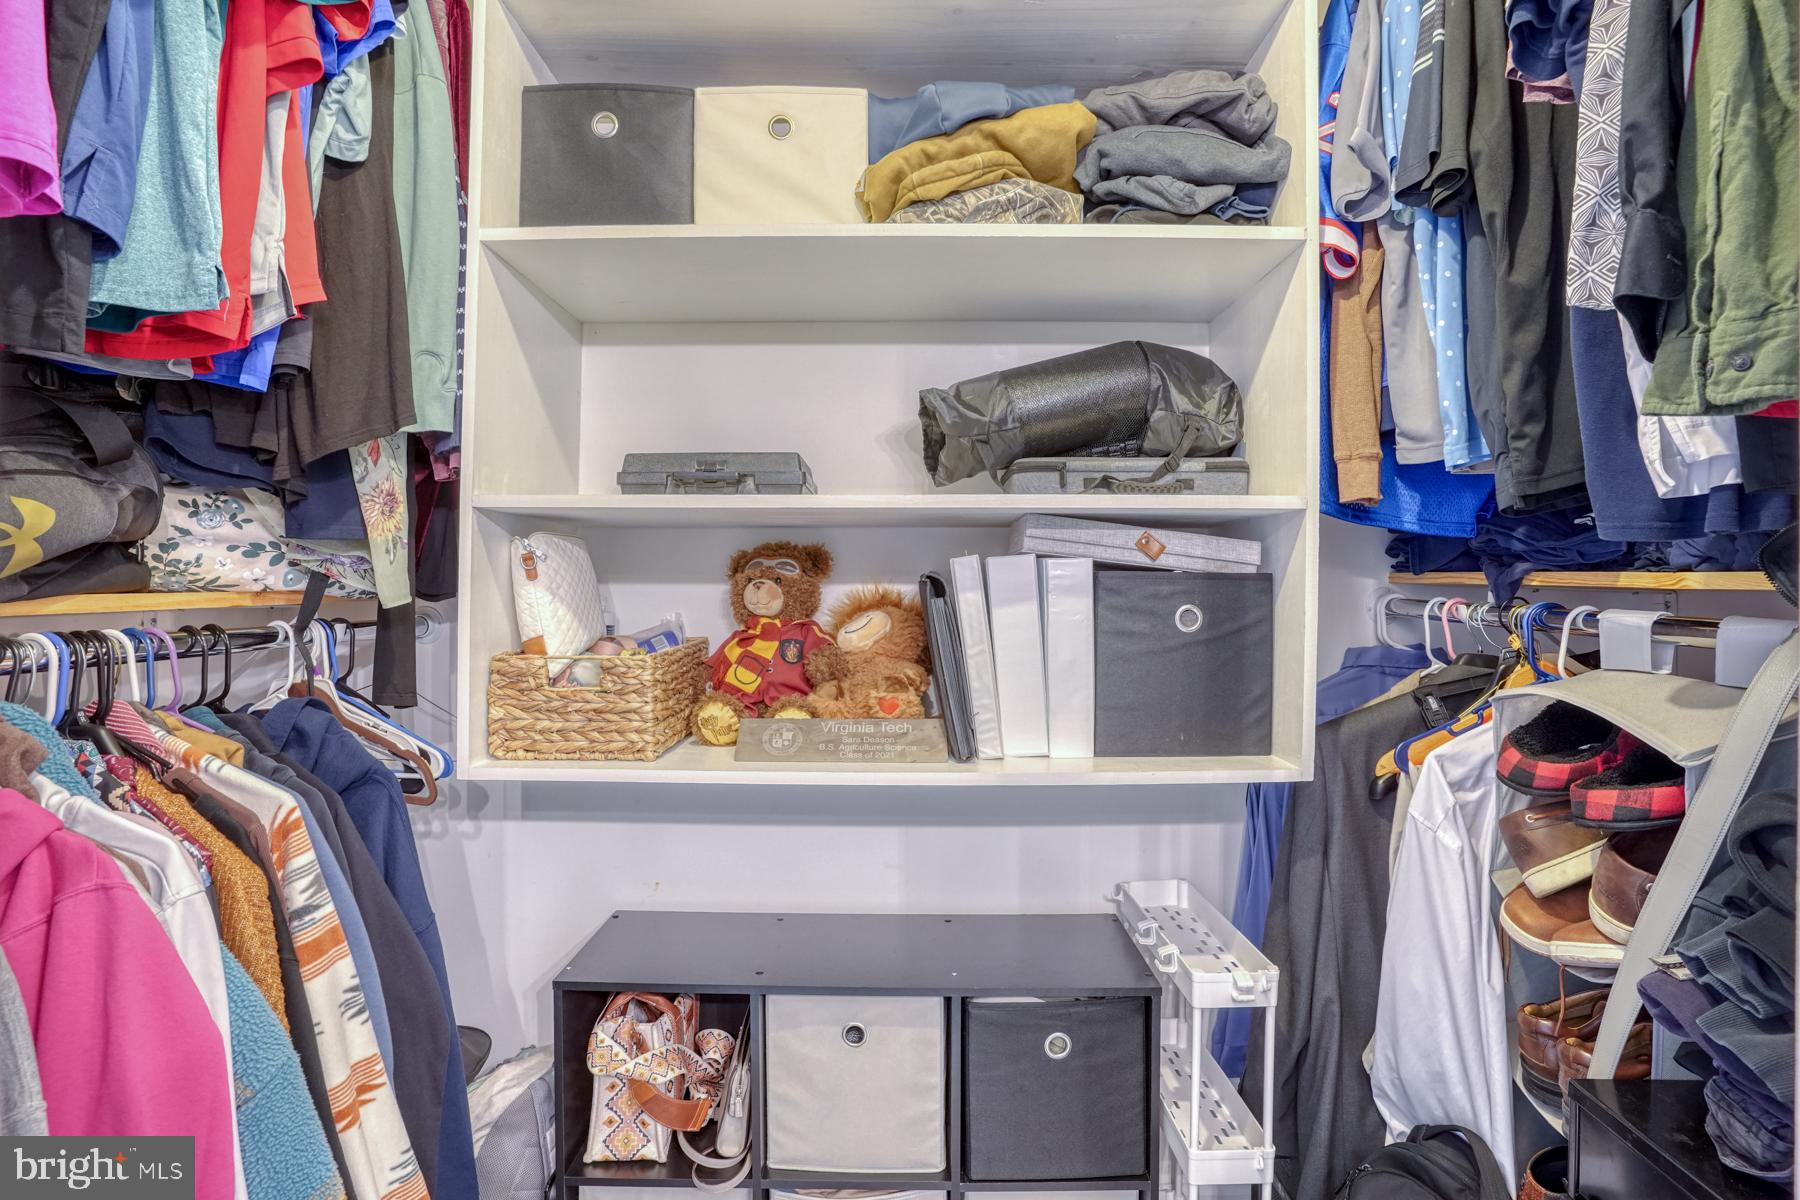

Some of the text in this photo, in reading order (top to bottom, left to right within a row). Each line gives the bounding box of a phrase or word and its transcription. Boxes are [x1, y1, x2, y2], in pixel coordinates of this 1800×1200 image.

[820, 721, 912, 735] Virginia Tech
[839, 743, 881, 752] Agriculture
[840, 751, 863, 759] Class
[864, 751, 873, 759] of
